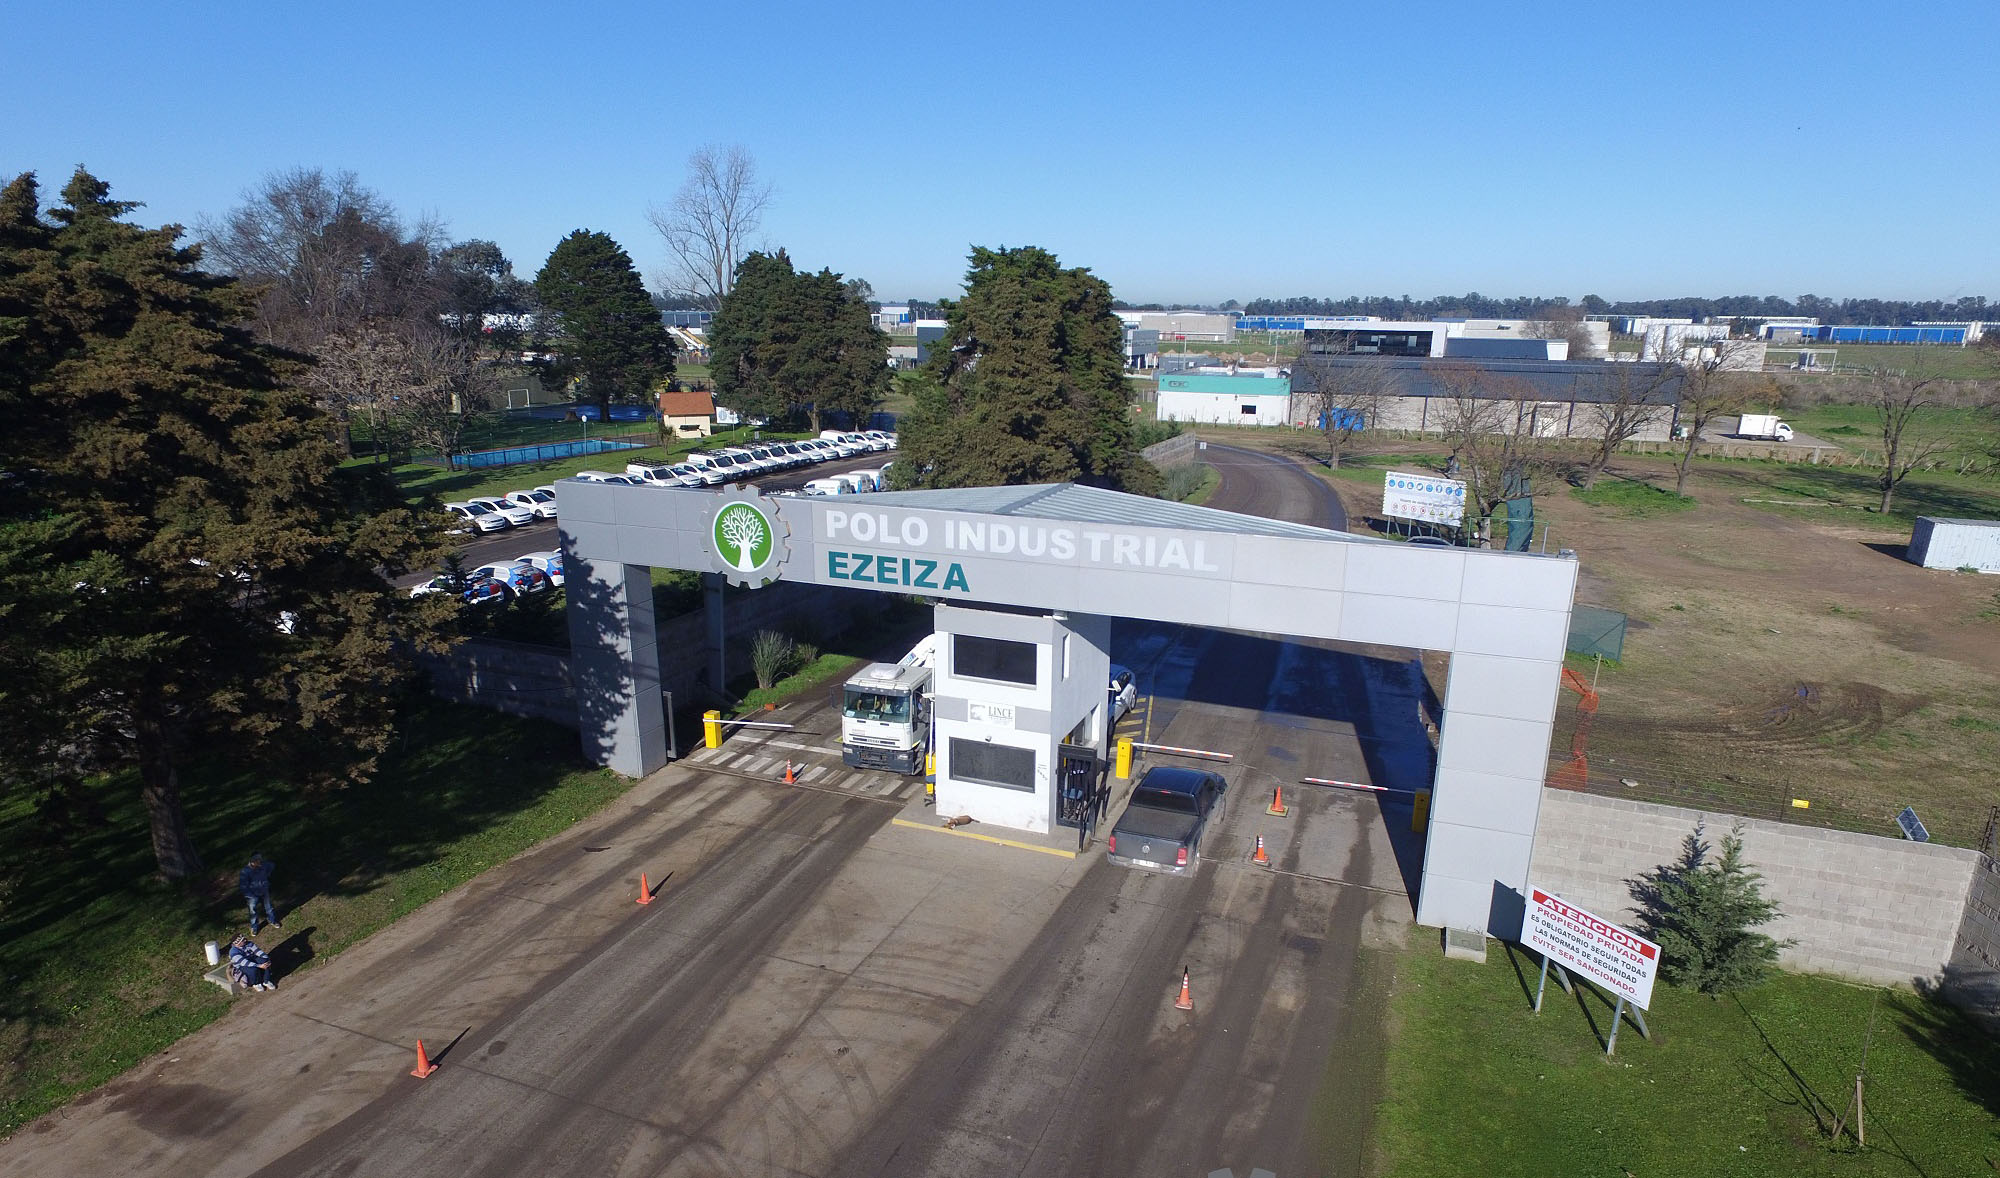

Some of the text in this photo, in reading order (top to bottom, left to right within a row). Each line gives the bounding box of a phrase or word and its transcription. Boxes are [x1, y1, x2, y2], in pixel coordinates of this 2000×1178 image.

[826, 509, 1219, 573] POLO INDUSTRIAL
[828, 550, 971, 593] EZEIZA
[988, 706, 1013, 720] LINCE
[1530, 914, 1647, 979] ES OBLIGATORIO SEGUIR TODAS
[1534, 926, 1637, 984] LAS NORMAS DE SEGURIDAD
[1537, 906, 1644, 966] PROPIEDAD PRIVADA
[1541, 898, 1642, 953] ATENCION
[1532, 935, 1638, 996] EVITE SER SANCIONADO.
